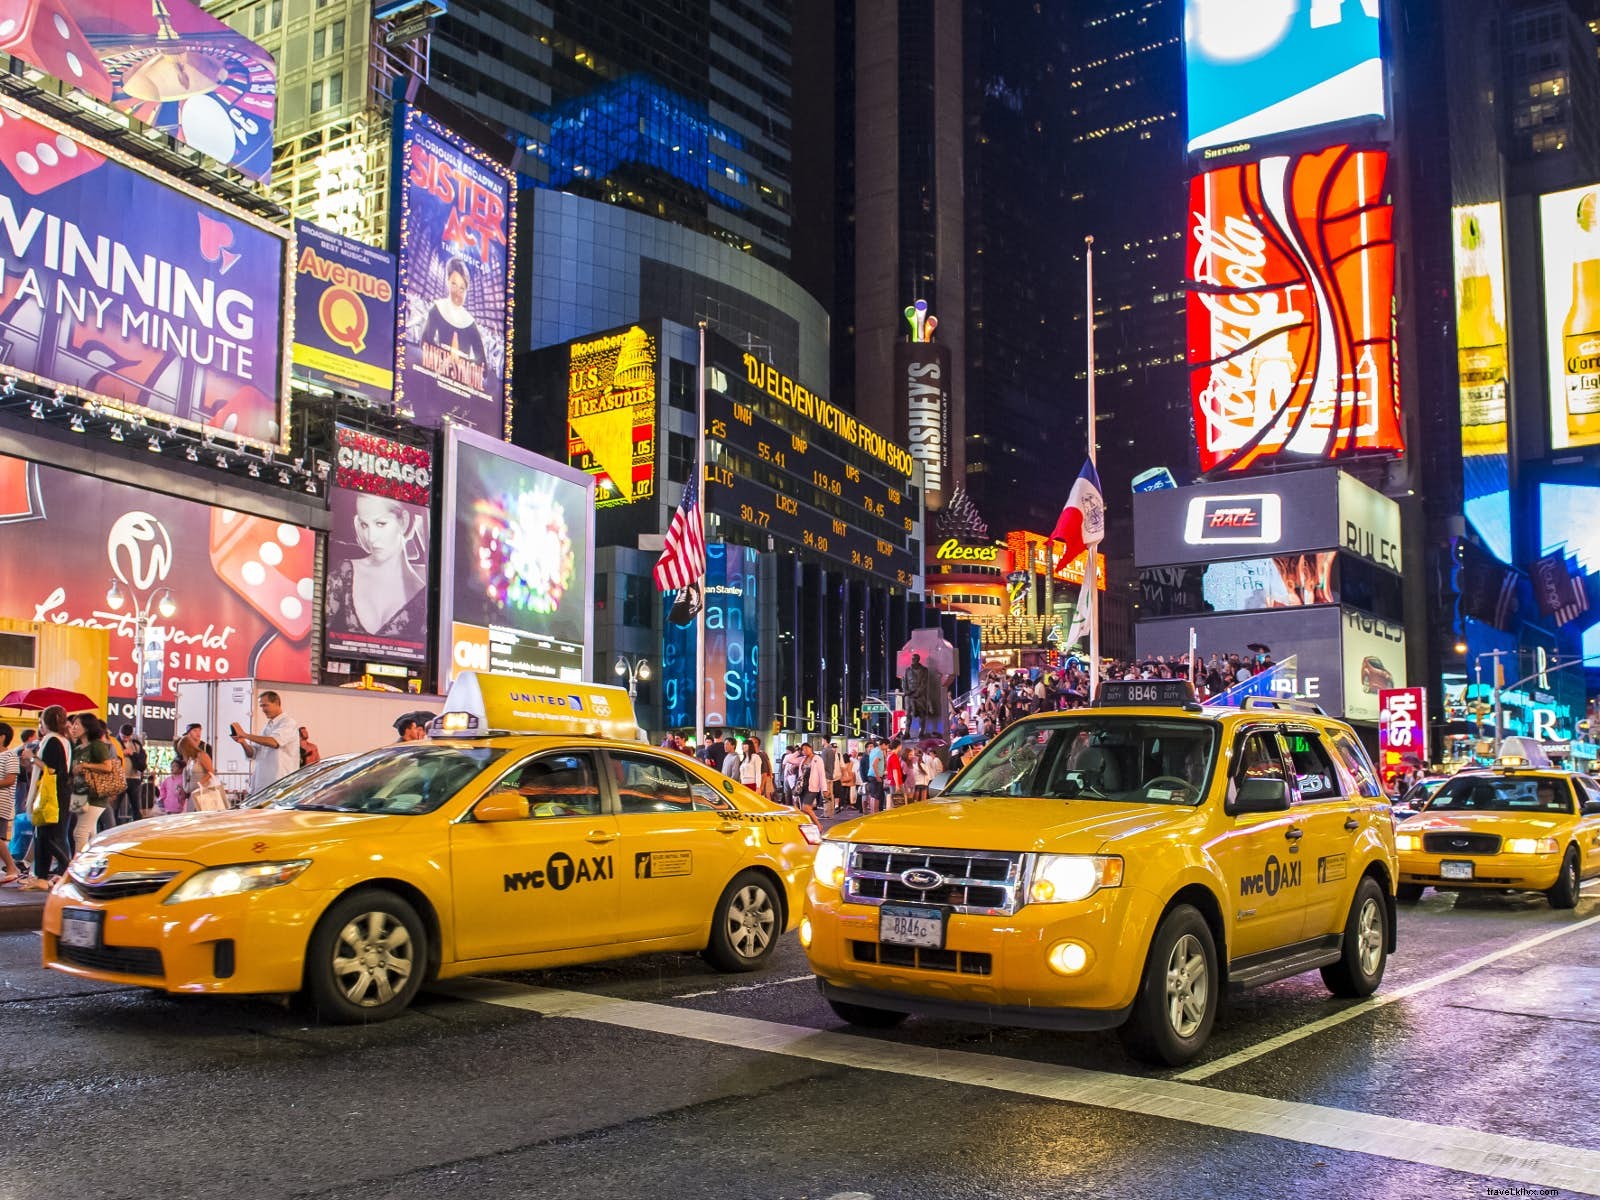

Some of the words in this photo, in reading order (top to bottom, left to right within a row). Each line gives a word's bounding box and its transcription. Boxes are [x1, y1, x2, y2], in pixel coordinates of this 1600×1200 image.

[415, 133, 461, 170] GLORIOUSLY
[463, 162, 503, 194] BROADWAY
[410, 144, 507, 246] SISTER
[443, 206, 497, 265] ACT
[0, 194, 253, 340] WINNING
[321, 241, 338, 253] BEST
[341, 248, 371, 265] MUSICAL
[298, 246, 392, 302] Avenue
[14, 268, 113, 329] ANY
[319, 285, 368, 354] Q
[121, 303, 253, 380] MINUTE
[570, 332, 629, 358] Bloomberg
[570, 367, 602, 392] U.S.
[766, 370, 813, 420] ELEVEN
[814, 396, 857, 444] VICTIMS
[858, 424, 886, 462] FROM
[337, 446, 430, 488] CHICAGO
[758, 442, 785, 469] 55.41
[813, 470, 841, 497] 119.60
[845, 464, 860, 484] UPS
[775, 493, 798, 517] LRCX
[1209, 512, 1258, 528] RACE
[740, 503, 770, 529] 30.77
[803, 530, 828, 552] 34.80
[936, 538, 998, 561] Reese's
[717, 584, 743, 597] Stanley
[131, 647, 230, 674] CSINO
[510, 692, 567, 706] UNITED
[1127, 685, 1158, 701] 8B46
[122, 703, 177, 720] QEENS
[1389, 692, 1418, 747] tkts
[1533, 708, 1569, 743] R
[503, 870, 545, 892] NYC
[1240, 874, 1264, 896] NYC
